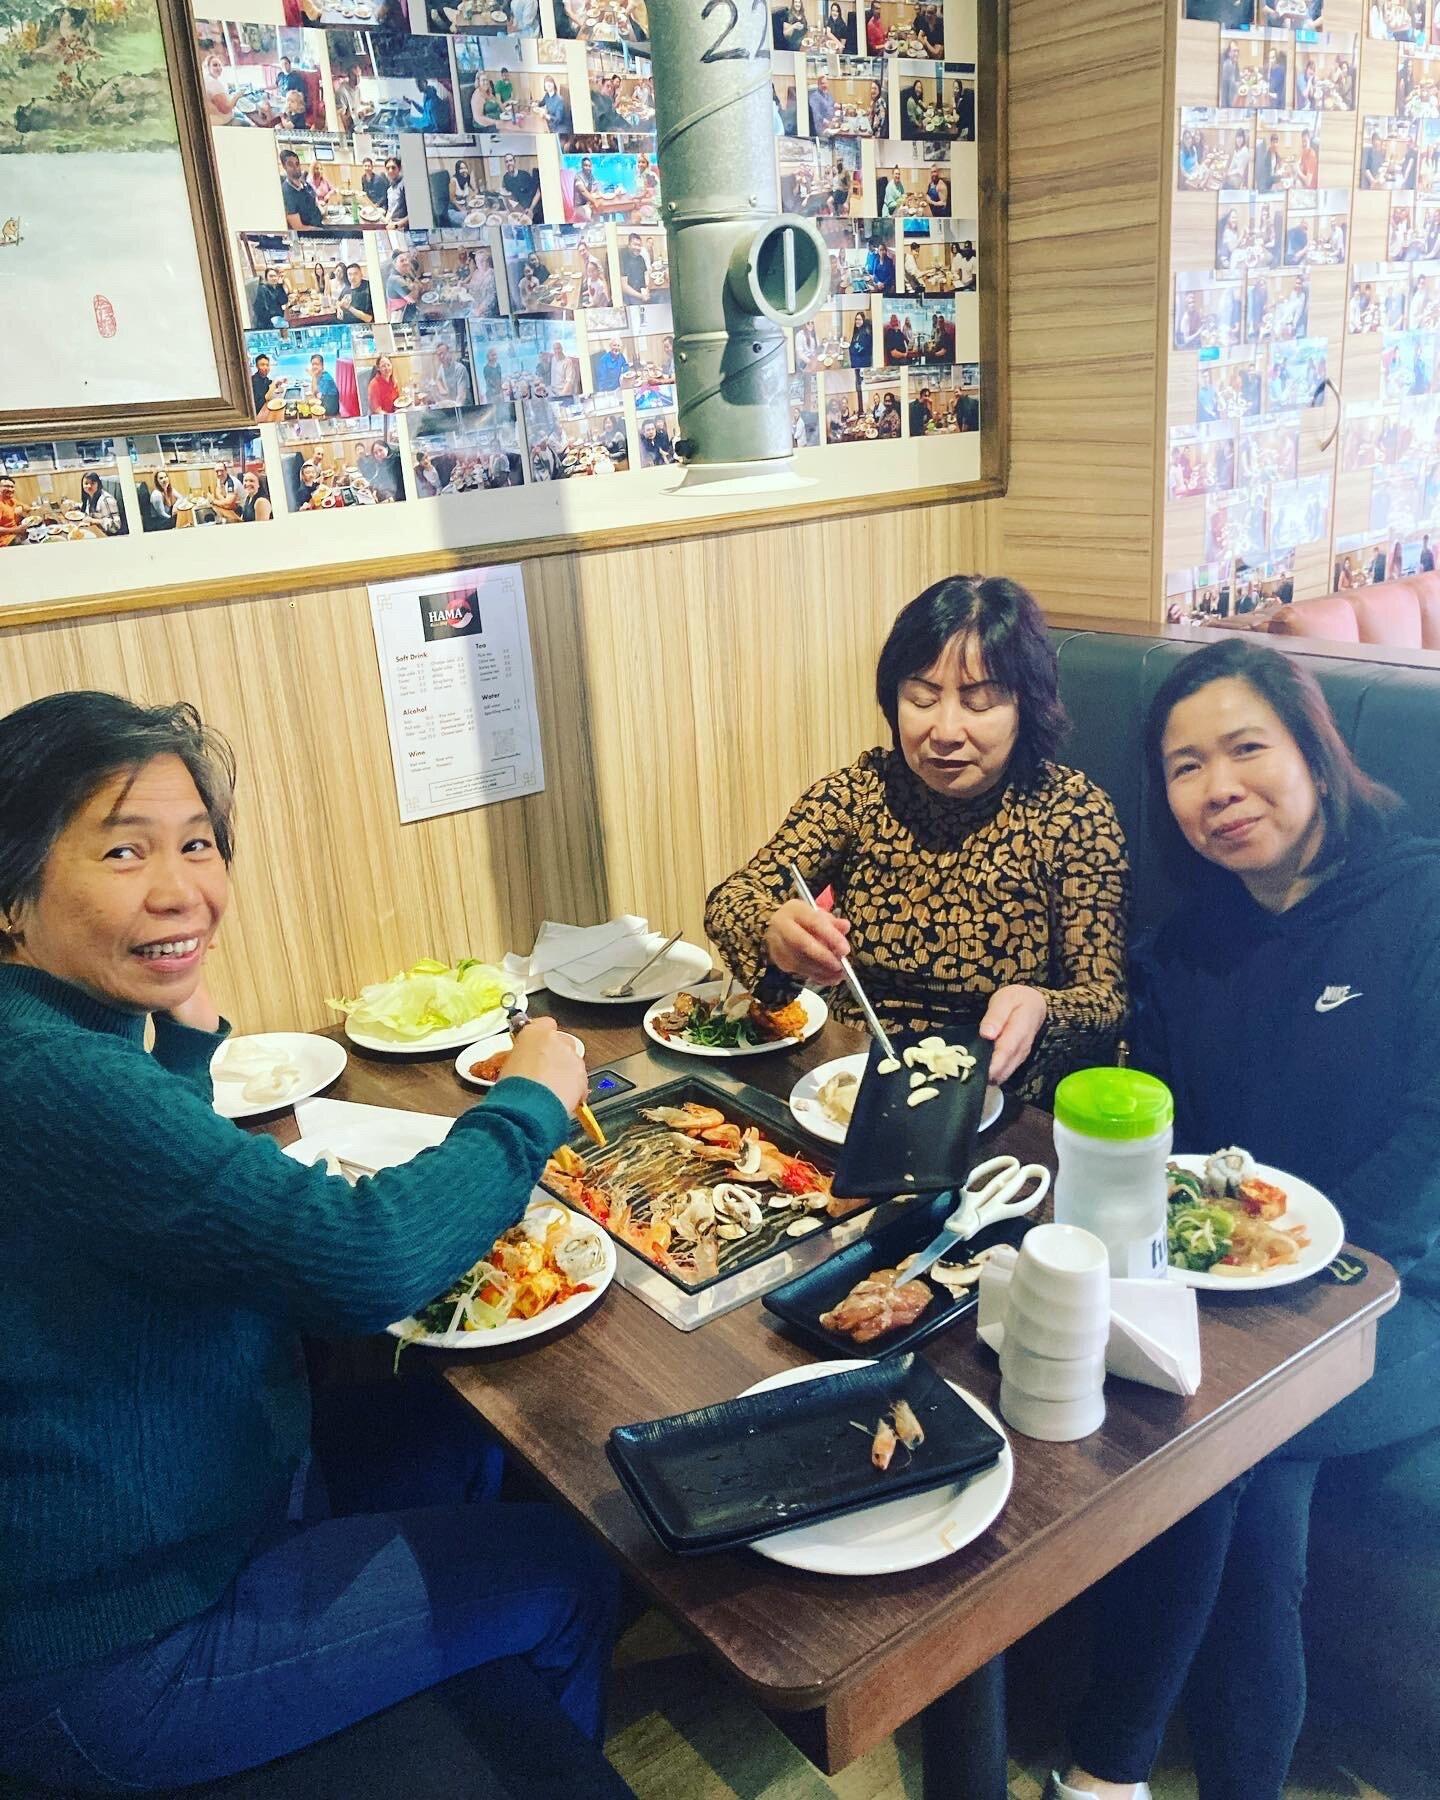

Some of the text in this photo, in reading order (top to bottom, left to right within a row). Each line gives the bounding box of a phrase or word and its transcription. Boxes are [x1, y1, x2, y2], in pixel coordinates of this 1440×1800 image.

[700, 0, 770, 63] 22
[428, 608, 463, 622] HAMA
[395, 652, 427, 663] Soft Drink
[402, 705, 427, 716] Alcohol
[408, 750, 426, 758] Wine
